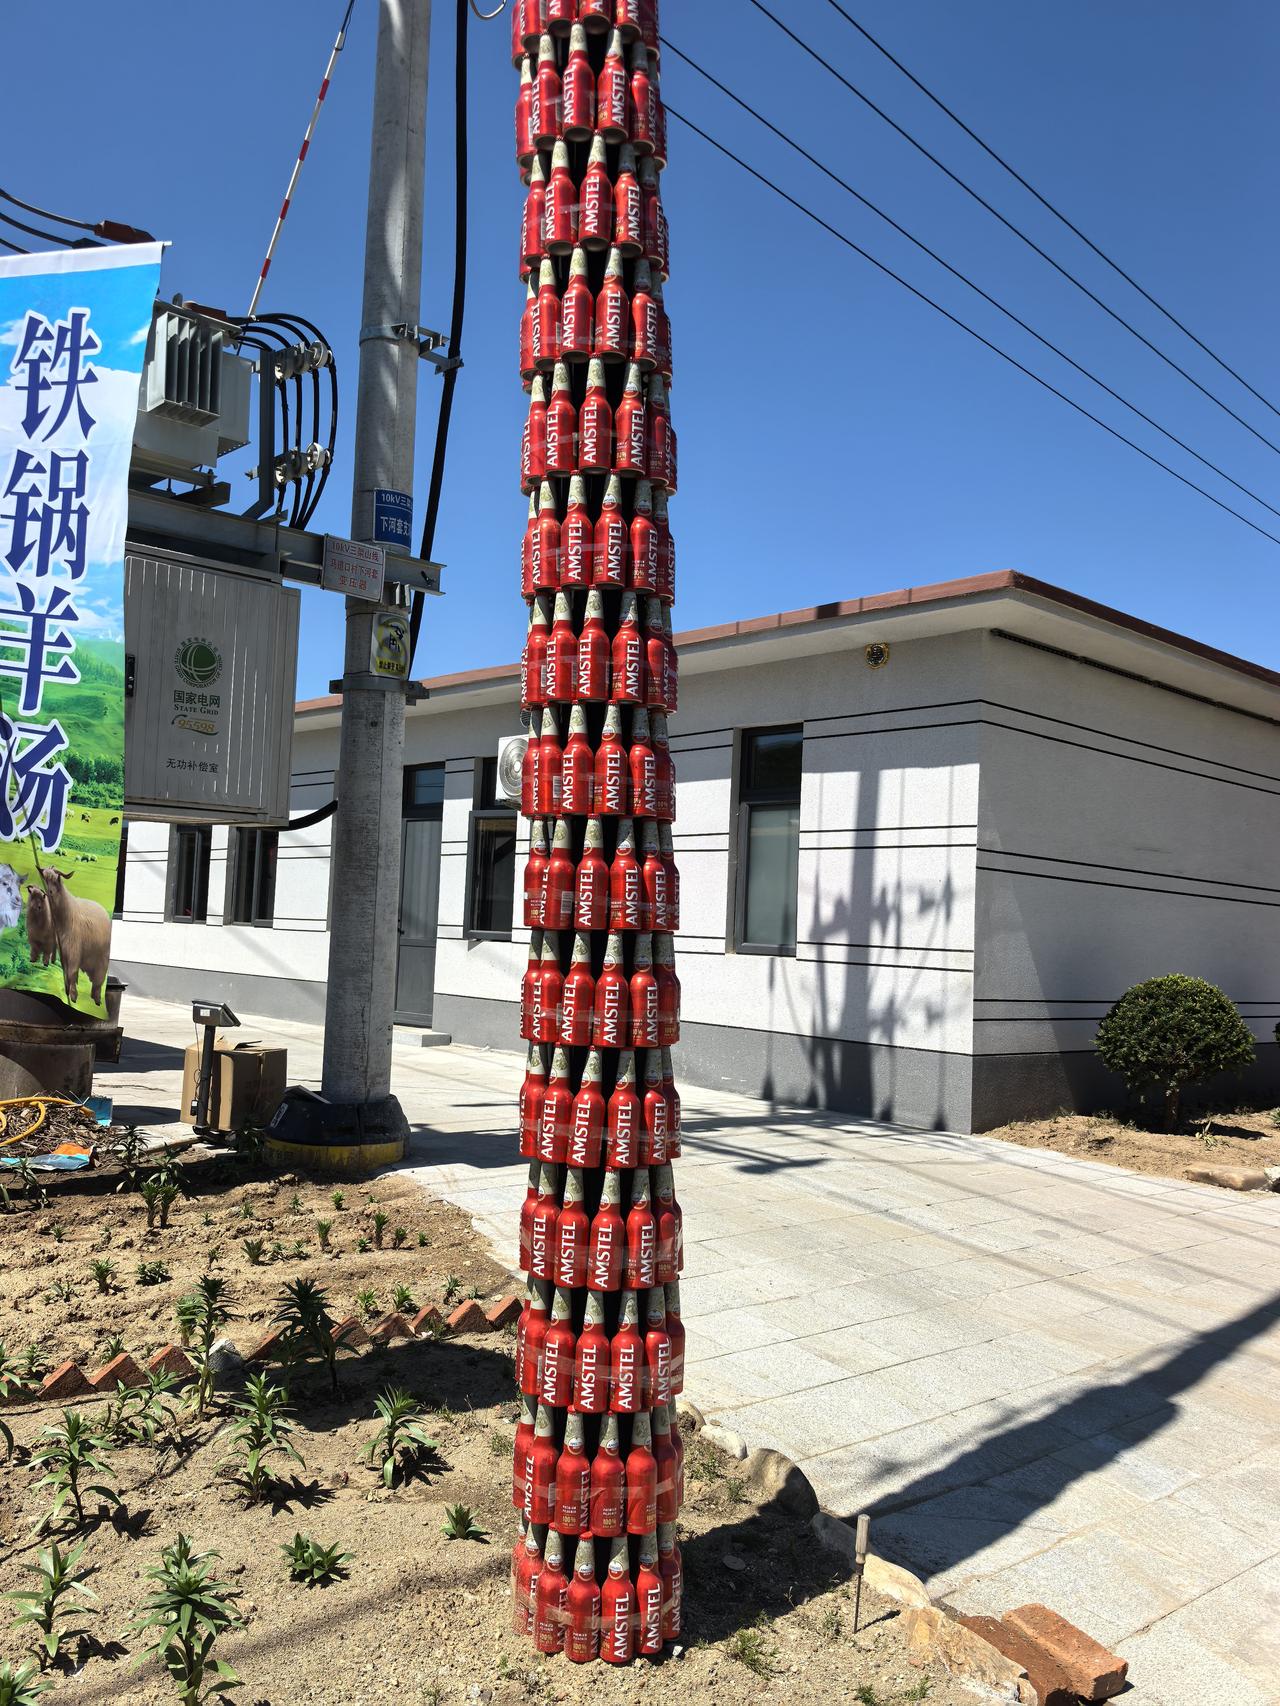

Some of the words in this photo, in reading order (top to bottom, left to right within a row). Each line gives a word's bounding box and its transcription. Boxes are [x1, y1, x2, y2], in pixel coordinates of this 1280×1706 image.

[564, 64, 576, 124] AMSTEL
[612, 70, 625, 126] AMSTEL
[628, 186, 640, 241] AMSTEL
[562, 291, 576, 348] AMSTEL
[606, 291, 621, 349] AMSTEL
[647, 303, 657, 355] AMSTEL
[547, 406, 560, 467] AMSTEL
[584, 402, 597, 463] AMSTEL
[631, 407, 645, 467] AMSTEL
[0, 311, 100, 849] 铁锅羊汤
[568, 520, 582, 580] AMSTEL
[608, 520, 622, 580] AMSTEL
[648, 529, 657, 586] AMSTEL
[546, 637, 556, 696] AMSTEL
[579, 634, 592, 695] AMSTEL
[626, 638, 640, 696] AMSTEL
[173, 689, 221, 708] 国家电网
[177, 718, 216, 733] 95598
[562, 748, 576, 809] AMSTEL
[606, 751, 620, 810] AMSTEL
[645, 754, 655, 812] AMSTEL
[579, 866, 594, 926] AMSTEL
[625, 866, 638, 926] AMSTEL
[656, 868, 665, 926] AMSTEL
[532, 978, 542, 1039] AMSTEL
[561, 976, 578, 1041] AMSTEL
[603, 983, 619, 1044] AMSTEL
[646, 983, 657, 1044] AMSTEL
[541, 1095, 557, 1160] AMSTEL
[572, 1101, 591, 1164] AMSTEL
[616, 1101, 632, 1165] AMSTEL
[652, 1098, 666, 1161] AMSTEL
[533, 1215, 546, 1277] AMSTEL
[560, 1221, 576, 1285] AMSTEL
[595, 1224, 612, 1288] AMSTEL
[641, 1221, 654, 1284] AMSTEL
[543, 1340, 559, 1403] AMSTEL
[581, 1344, 597, 1409] AMSTEL
[618, 1344, 634, 1409] AMSTEL
[658, 1338, 671, 1401] AMSTEL
[524, 1455, 535, 1520] AMSTEL
[614, 1592, 630, 1658] AMSTEL
[647, 1583, 661, 1649] AMSTEL
